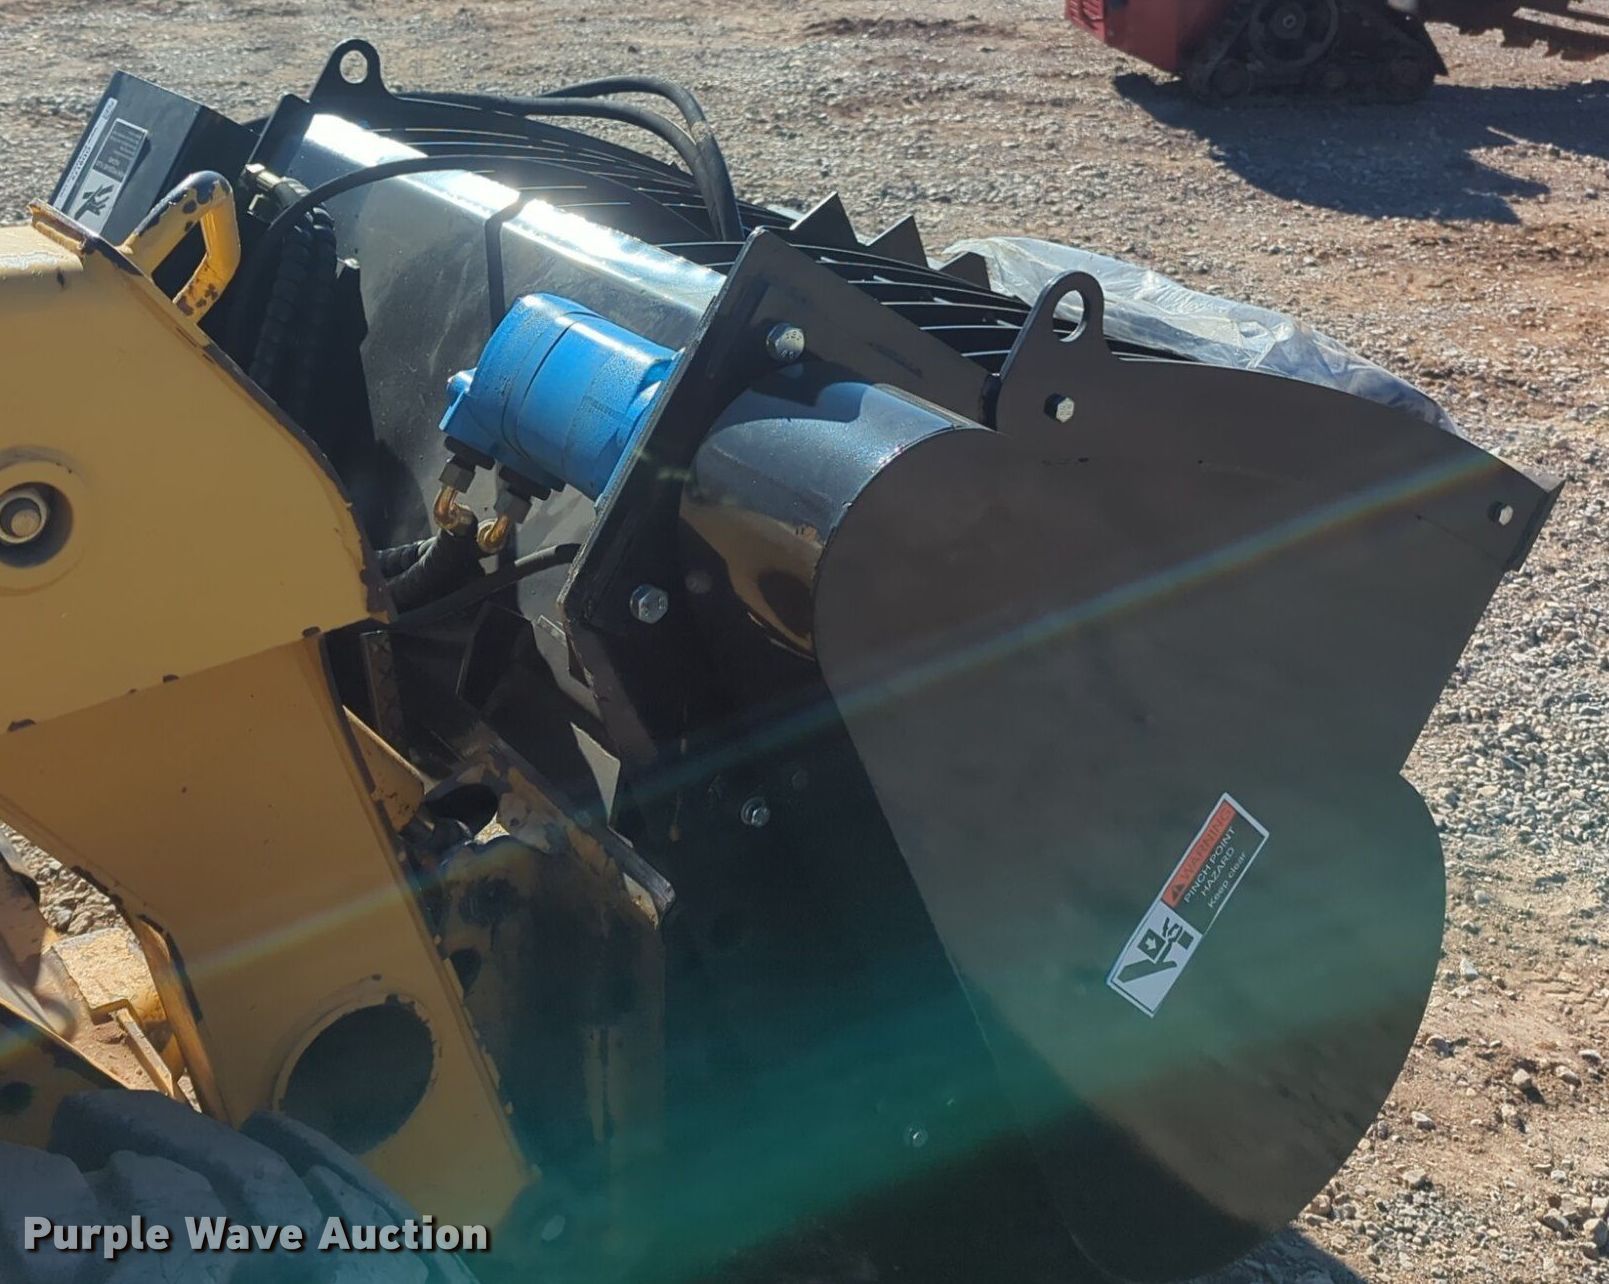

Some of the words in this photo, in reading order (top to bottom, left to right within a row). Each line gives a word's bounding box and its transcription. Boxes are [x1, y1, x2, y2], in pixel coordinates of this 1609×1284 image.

[1179, 805, 1232, 880] WARNING
[1184, 864, 1211, 903] PINCH
[1209, 826, 1236, 864] POINT
[1200, 846, 1235, 896] HAZARD
[1207, 879, 1229, 908] Keep
[1228, 851, 1247, 879] clear
